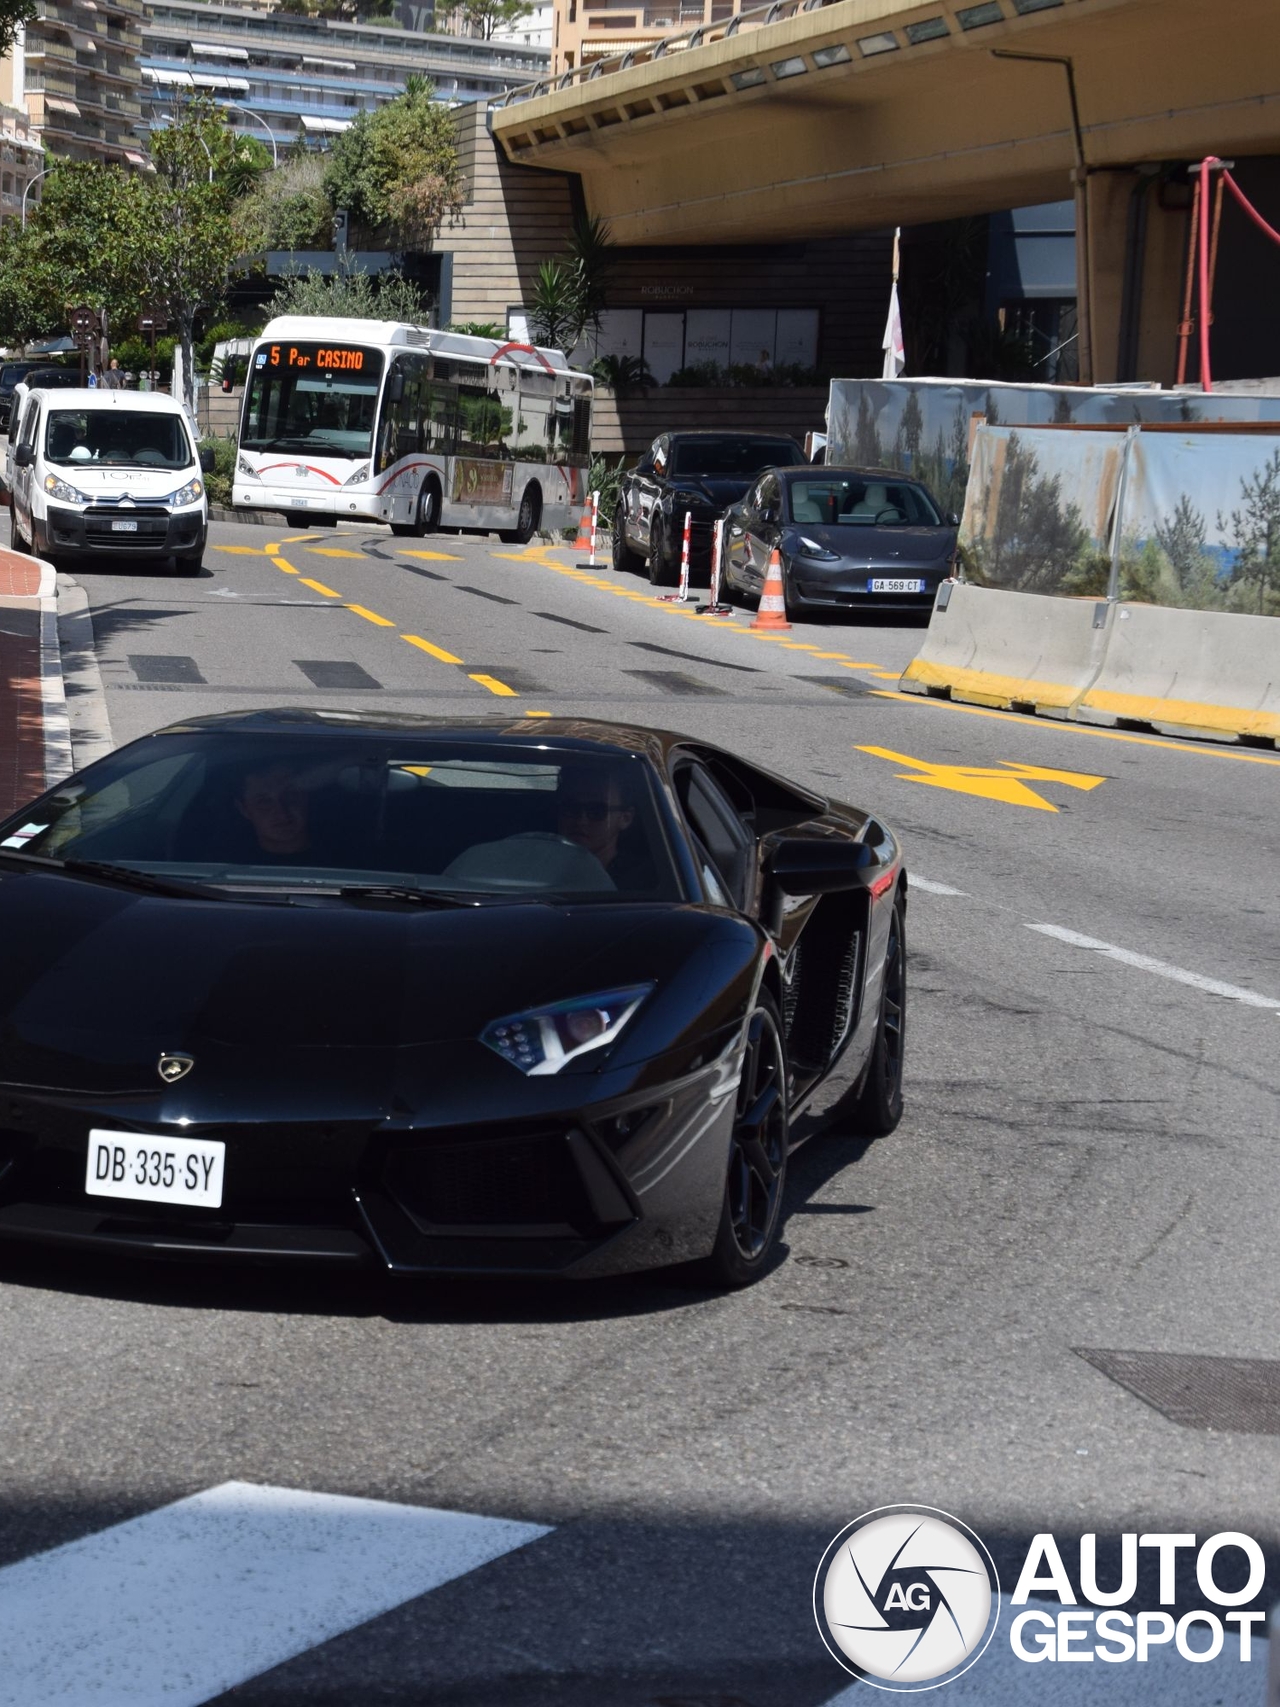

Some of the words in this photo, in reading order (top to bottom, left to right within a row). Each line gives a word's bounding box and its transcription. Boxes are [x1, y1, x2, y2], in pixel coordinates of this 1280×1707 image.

[640, 285, 694, 295] ROBUCHON
[271, 346, 281, 366] 5
[289, 347, 311, 366] Par
[316, 349, 364, 370] CASINO
